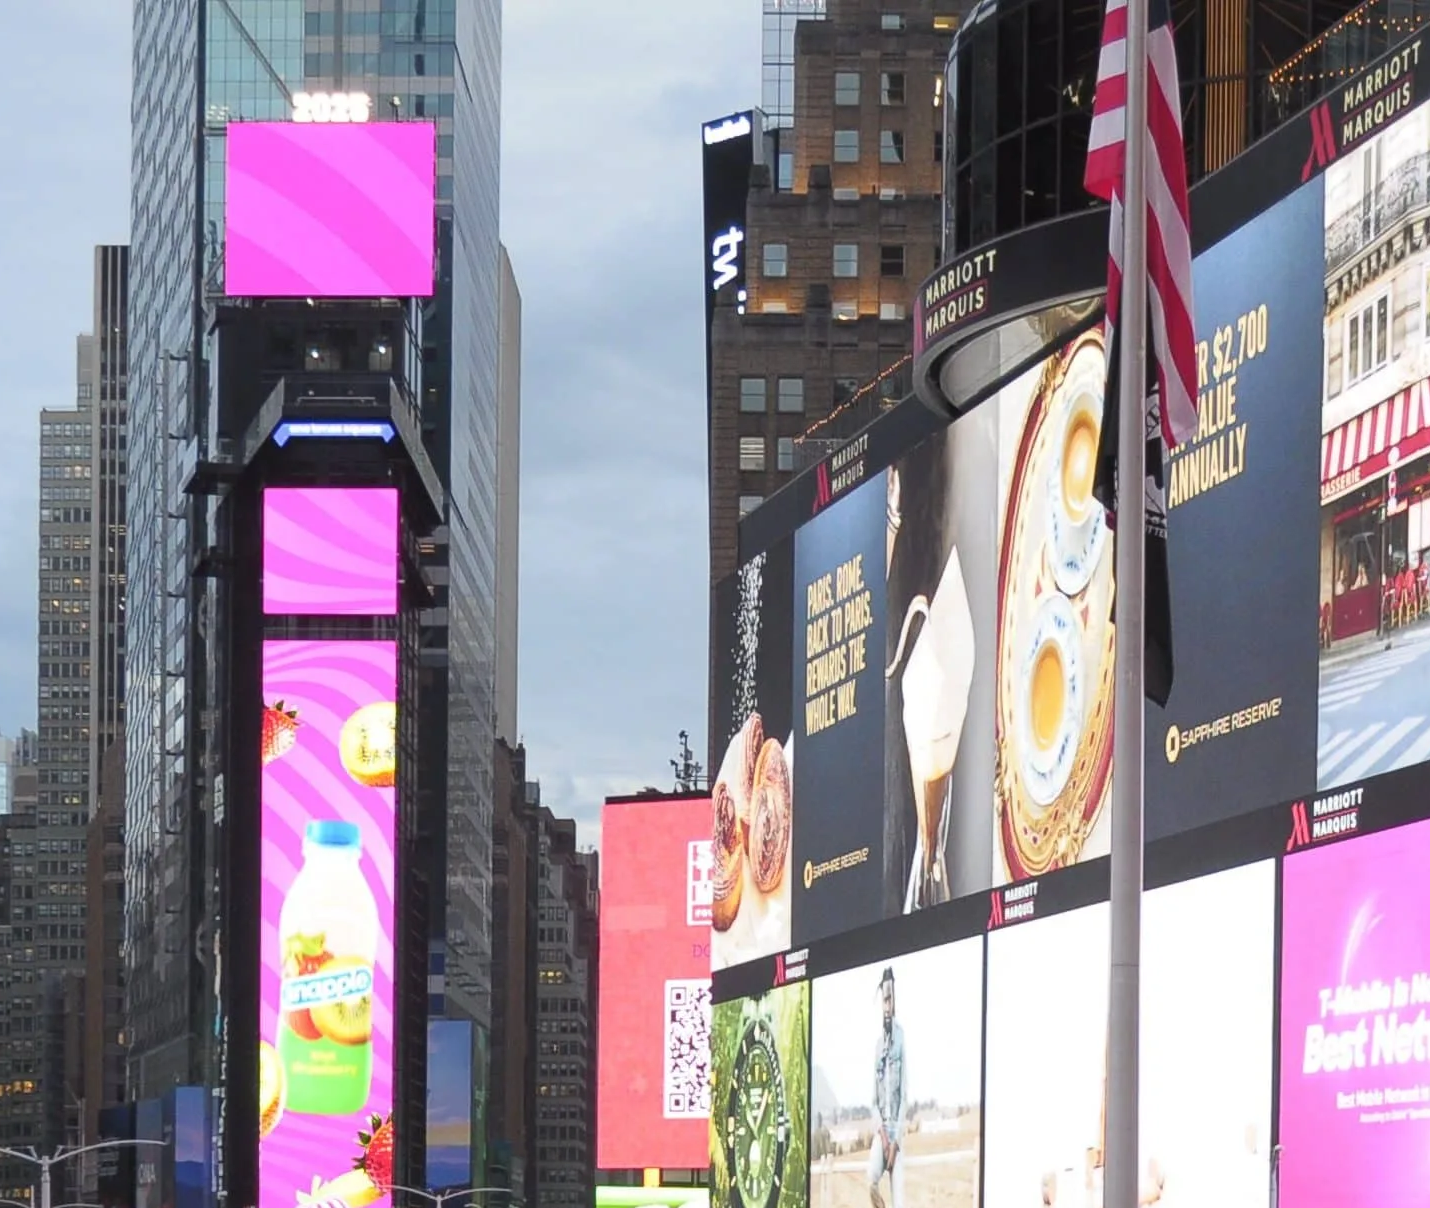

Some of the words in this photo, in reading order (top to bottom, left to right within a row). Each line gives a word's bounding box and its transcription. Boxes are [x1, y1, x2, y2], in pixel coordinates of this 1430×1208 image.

[1341, 40, 1422, 113] MARRIOTT
[1341, 83, 1412, 147] MARQUIS
[924, 248, 998, 307] MARRIOTT
[924, 286, 987, 339] MARQUIS
[1213, 303, 1268, 382] $2,700
[1193, 375, 1238, 444] ALUE
[1169, 422, 1247, 510] ANNUALLY
[806, 571, 835, 620] PARIS.
[835, 552, 865, 603] ROME.
[805, 613, 830, 660] BACK
[830, 604, 842, 643] TO
[806, 646, 847, 699] REWARDS
[847, 632, 867, 675] THE
[805, 689, 837, 738] WHOLE
[1180, 714, 1231, 749] SAPPHIRE
[1313, 787, 1364, 817] MARRIOTT
[1313, 812, 1358, 839] MARQUIS
[1318, 979, 1392, 1019] T-Mobile
[1302, 1016, 1370, 1075] Best
